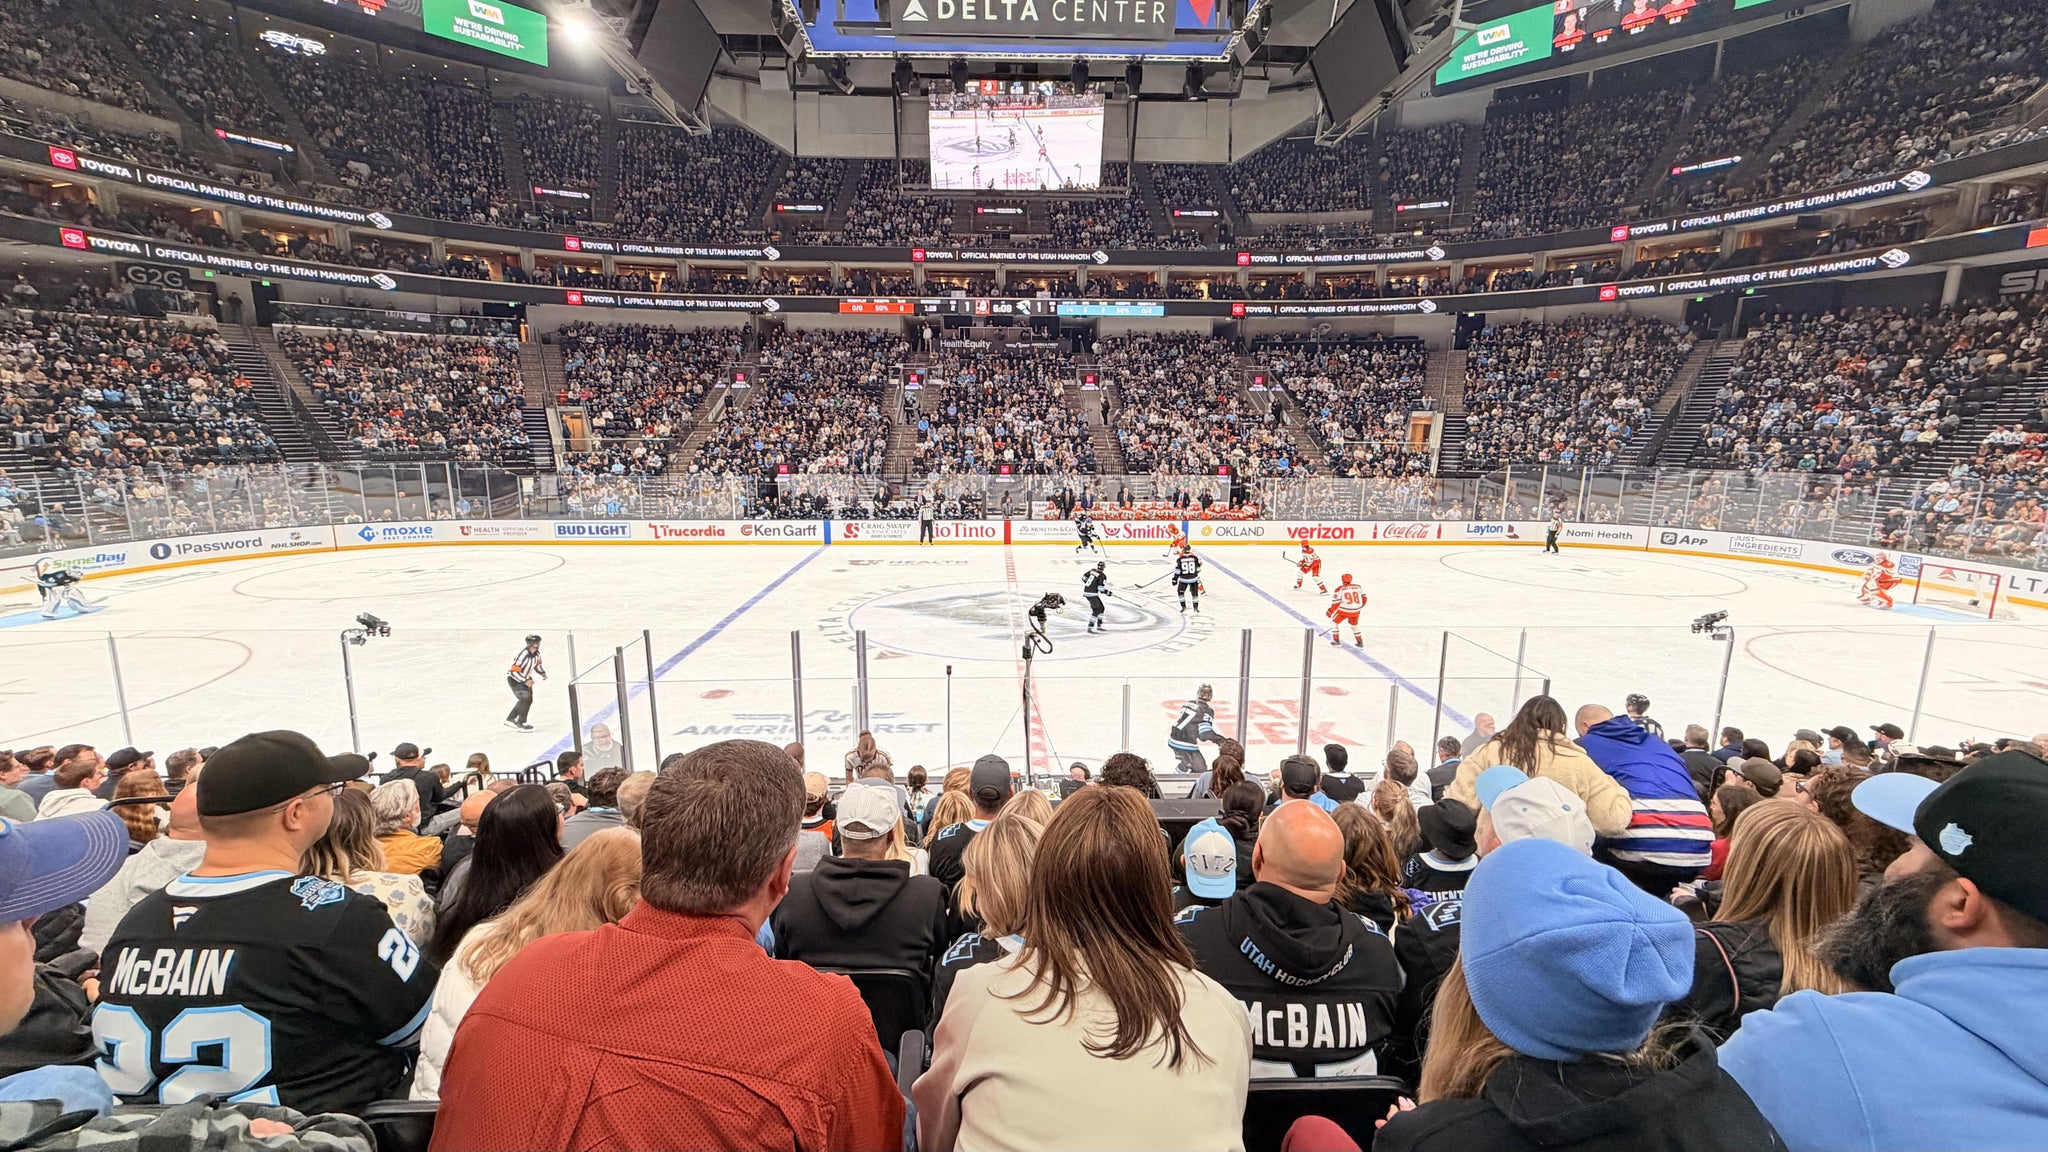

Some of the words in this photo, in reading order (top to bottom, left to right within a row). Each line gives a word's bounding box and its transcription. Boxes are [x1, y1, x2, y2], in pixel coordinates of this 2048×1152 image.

[472, 5, 500, 20] WM
[937, 0, 1039, 21] DELTA
[1052, 0, 1165, 24] CENTER
[454, 16, 484, 32] WE'RE
[485, 24, 519, 43] DRIVING
[1482, 28, 1506, 41] WM
[1463, 47, 1489, 63] WE'RE
[1490, 41, 1524, 56] DRIVING
[77, 157, 133, 179] TOYOTA
[146, 173, 199, 192] OFFICIAL
[200, 184, 246, 202] PARTNER
[247, 194, 263, 204] OF
[264, 197, 285, 209] THE
[286, 201, 313, 213] UTAH
[314, 206, 366, 222] MAMMOTH
[1680, 214, 1722, 228] OFFICIAL
[1723, 206, 1766, 221] PARTNER
[1767, 203, 1784, 214] OF
[1784, 199, 1805, 211] THE
[1806, 193, 1835, 207] UTAH
[1835, 180, 1897, 200] MAMMOTH
[1630, 222, 1668, 236] TOYOTA
[87, 236, 141, 254] TOYOTA
[581, 241, 614, 251] TOYOTA
[622, 244, 654, 254] OFFICIAL
[654, 246, 685, 255] PARTNER
[685, 247, 695, 255] OF
[695, 248, 709, 256] THE
[709, 248, 727, 256] UTAH
[727, 249, 762, 257] MAMMOTH
[925, 251, 953, 259] TOYOTA
[961, 252, 989, 260] OFFICIAL
[989, 252, 1017, 260] PARTNER
[1017, 252, 1027, 260] OF
[1027, 252, 1040, 260] THE
[1057, 253, 1091, 261] MAMMOTH
[1250, 255, 1278, 263] TOYOTA
[1286, 255, 1313, 263] OFFICIAL
[1314, 254, 1343, 262] PARTNER
[1343, 253, 1354, 262] OF
[1354, 253, 1367, 261] THE
[1367, 252, 1386, 261] UTAH
[1386, 250, 1424, 260] MAMMOTH
[155, 247, 206, 264] OFFICIAL
[207, 255, 253, 270] PARTNER
[254, 262, 270, 272] OF
[270, 264, 291, 275] THE
[291, 267, 318, 278] UTAH
[319, 270, 370, 284] MAMMOTH
[126, 265, 184, 288] G2G
[1667, 278, 1708, 291] OFFICIAL
[1709, 273, 1750, 286] PARTNER
[1751, 272, 1767, 282] OF
[1768, 269, 1788, 280] THE
[1791, 265, 1817, 278] UTAH
[1818, 256, 1877, 273] MAMMOTH
[1618, 284, 1656, 296] TOYOTA
[582, 295, 615, 305] TOYOTA
[623, 297, 655, 306] OFFICIAL
[655, 298, 685, 307] PARTNER
[685, 299, 696, 307] OF
[695, 299, 709, 307] THE
[709, 300, 727, 308] UTAH
[727, 300, 762, 308] MAMMOTH
[965, 301, 970, 312] 1
[992, 304, 1013, 313] 6:08
[1036, 302, 1042, 312] 1
[1244, 305, 1272, 313] TOYOTA
[1279, 305, 1307, 313] OFFICIAL
[1308, 305, 1336, 313] PARTNER
[1336, 305, 1347, 313] OF
[1360, 304, 1379, 312] UTAH
[1379, 303, 1416, 311] MAMMOTH
[940, 340, 991, 350] HealthEquity
[382, 525, 433, 536] moxie
[557, 525, 585, 536] BUD
[588, 525, 628, 536] LIGHT
[660, 524, 725, 537] Trucordia
[754, 524, 781, 537] Ken
[783, 523, 817, 537] Garff
[1122, 523, 1172, 539] Smith's
[1215, 526, 1265, 537] OKLAND
[1287, 523, 1354, 539] verizon
[1466, 523, 1503, 536] Layton
[1566, 529, 1595, 538] Nomi
[1597, 529, 1633, 540] Health
[175, 536, 263, 555] 1Password
[1734, 541, 1799, 554] INGREDIENTS
[53, 552, 126, 569] SameDay
[1838, 550, 1869, 565] Ford
[1181, 561, 1196, 575] 98
[1344, 591, 1360, 605] 98
[1188, 854, 1237, 873] FITZ
[1240, 936, 1276, 975] UTAH
[1275, 968, 1331, 987] HOCKEY
[1330, 943, 1354, 978] CLUB
[109, 946, 236, 997] McBAIN
[1250, 1001, 1368, 1049] McBAIN
